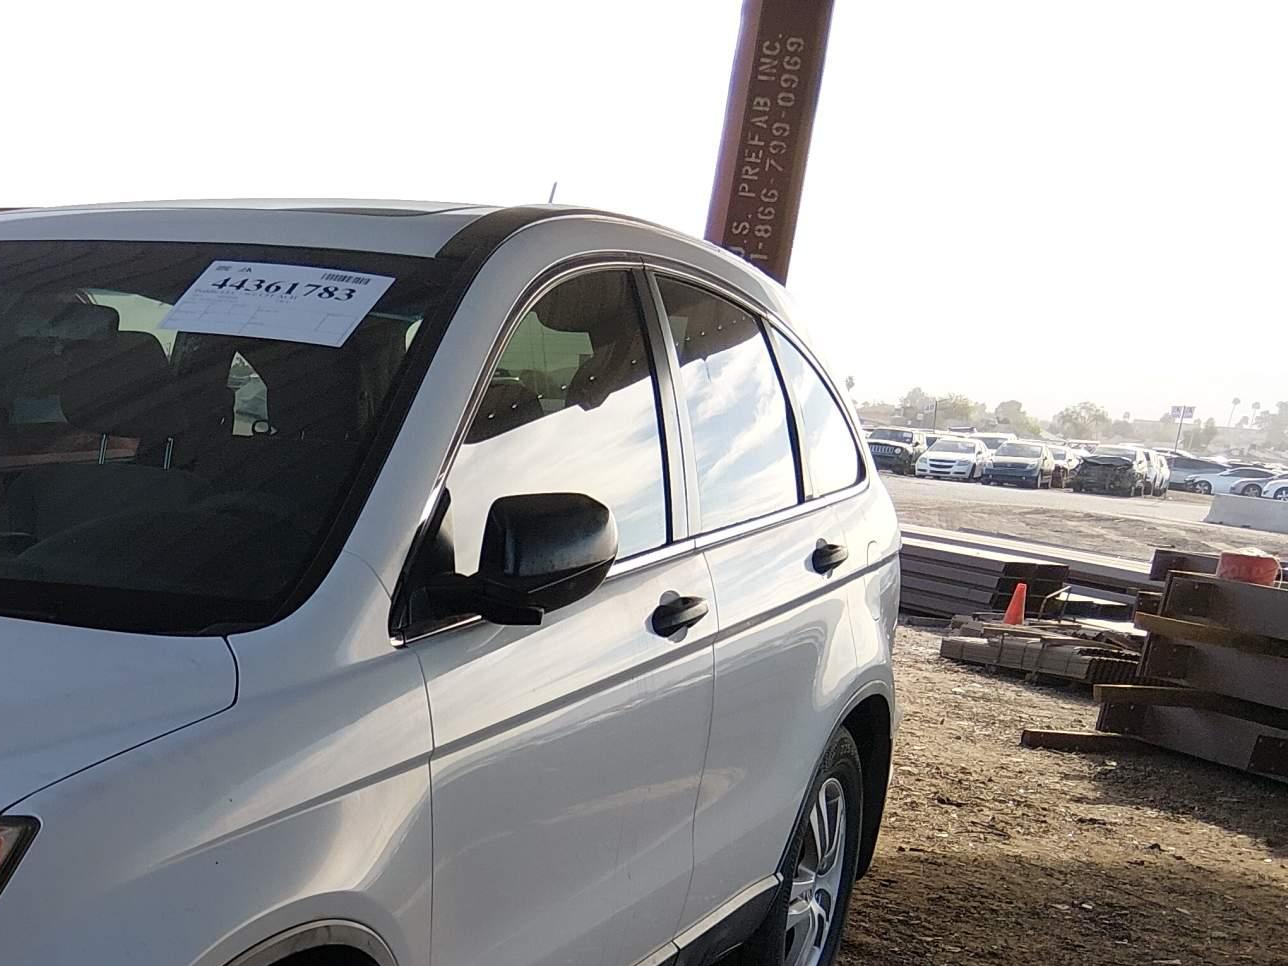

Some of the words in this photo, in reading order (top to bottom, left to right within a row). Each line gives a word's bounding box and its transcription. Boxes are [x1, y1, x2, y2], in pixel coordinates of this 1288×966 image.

[738, 96, 772, 198] PREFAB
[757, 33, 785, 82] INC.
[749, 37, 806, 262] 1-866-799-0969
[210, 276, 357, 303] 44361783
